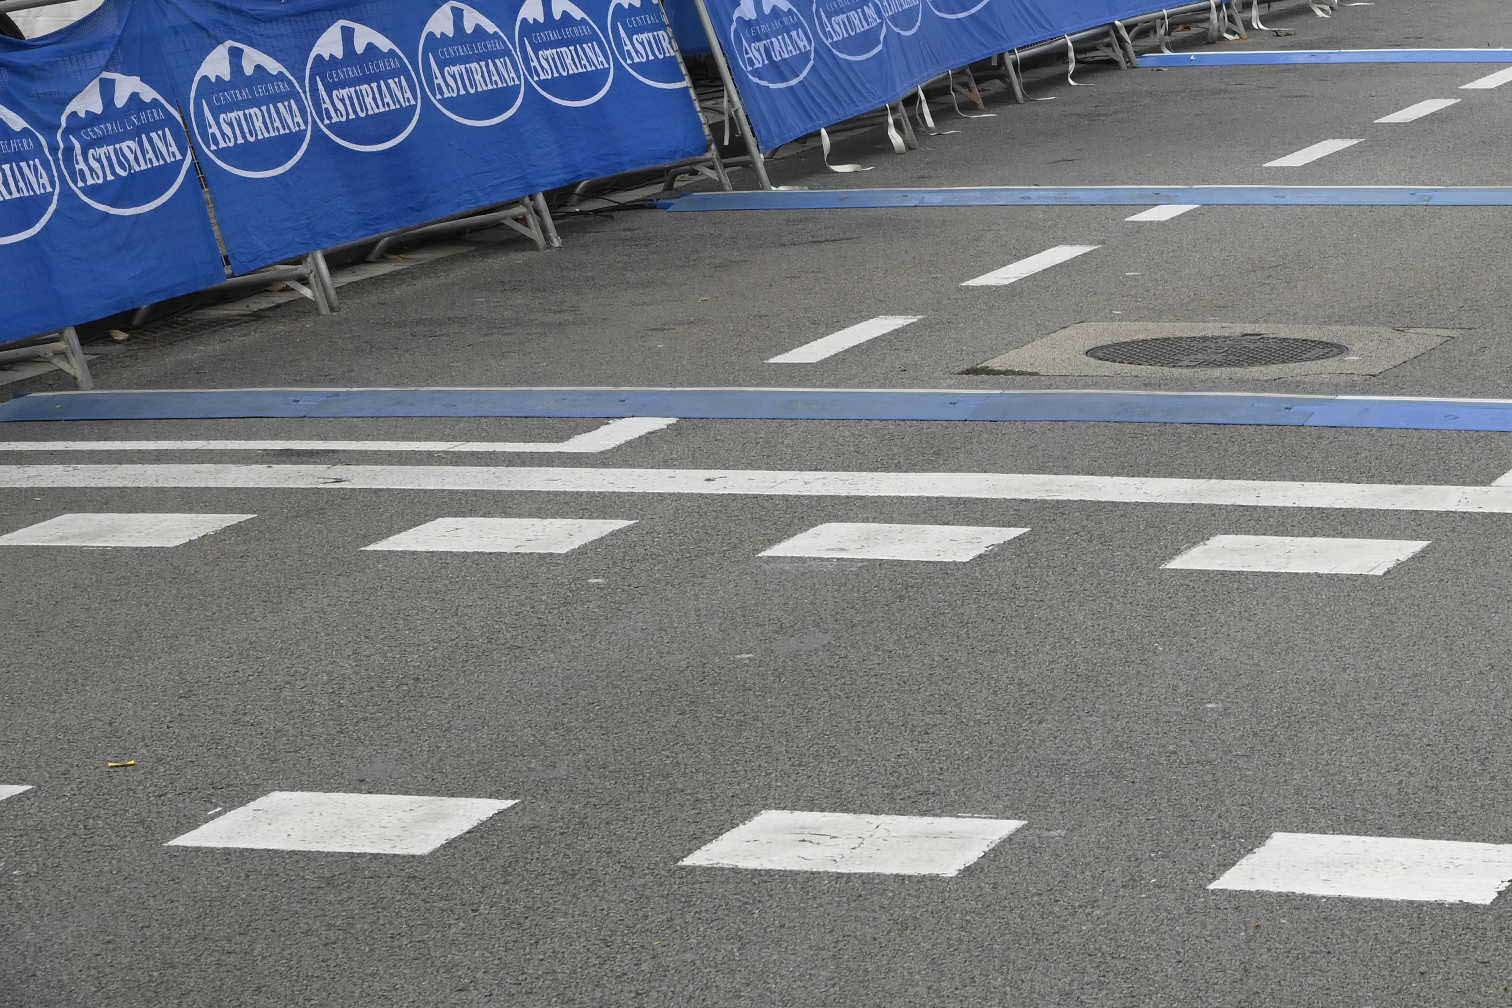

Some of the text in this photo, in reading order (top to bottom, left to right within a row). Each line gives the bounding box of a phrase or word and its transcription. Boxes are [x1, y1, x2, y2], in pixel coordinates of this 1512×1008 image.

[429, 52, 520, 101] ASTURIANA
[525, 38, 609, 81] ASTURIANA
[202, 99, 306, 151] ASTURIANA
[316, 75, 416, 126] ASTURIANA
